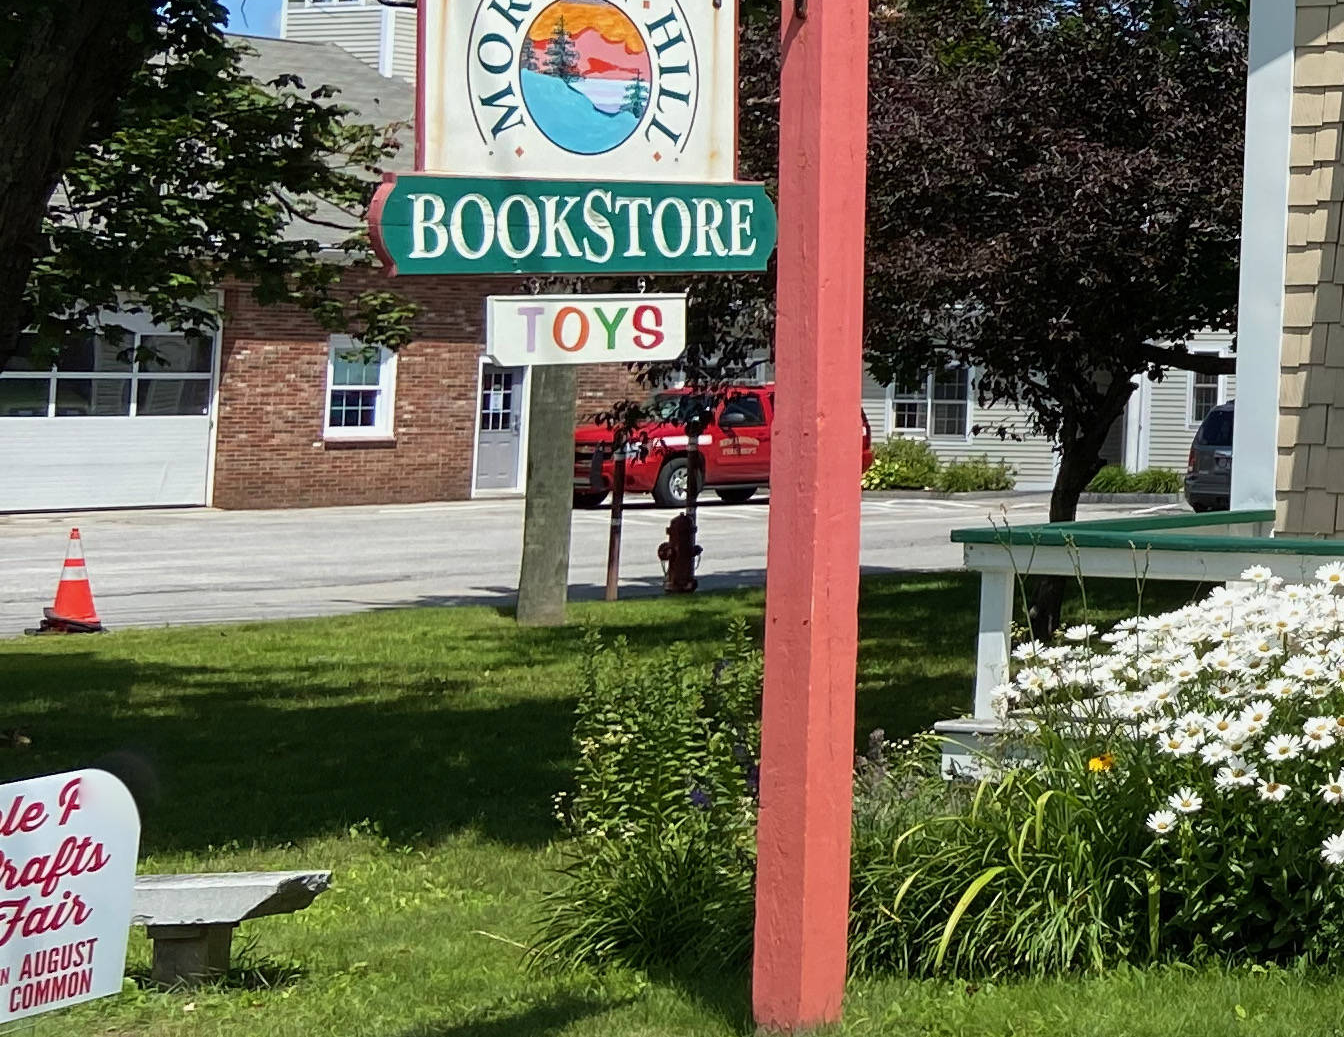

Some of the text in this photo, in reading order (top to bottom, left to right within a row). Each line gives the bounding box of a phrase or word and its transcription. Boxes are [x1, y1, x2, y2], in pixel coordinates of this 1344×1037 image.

[644, 6, 692, 148] HILL
[408, 188, 757, 263] BOOKSTORE
[517, 305, 665, 352] TOYS
[0, 795, 49, 836] le
[0, 890, 94, 947] Fair
[18, 937, 98, 981] AUGUST
[9, 967, 93, 1013] COMMON
